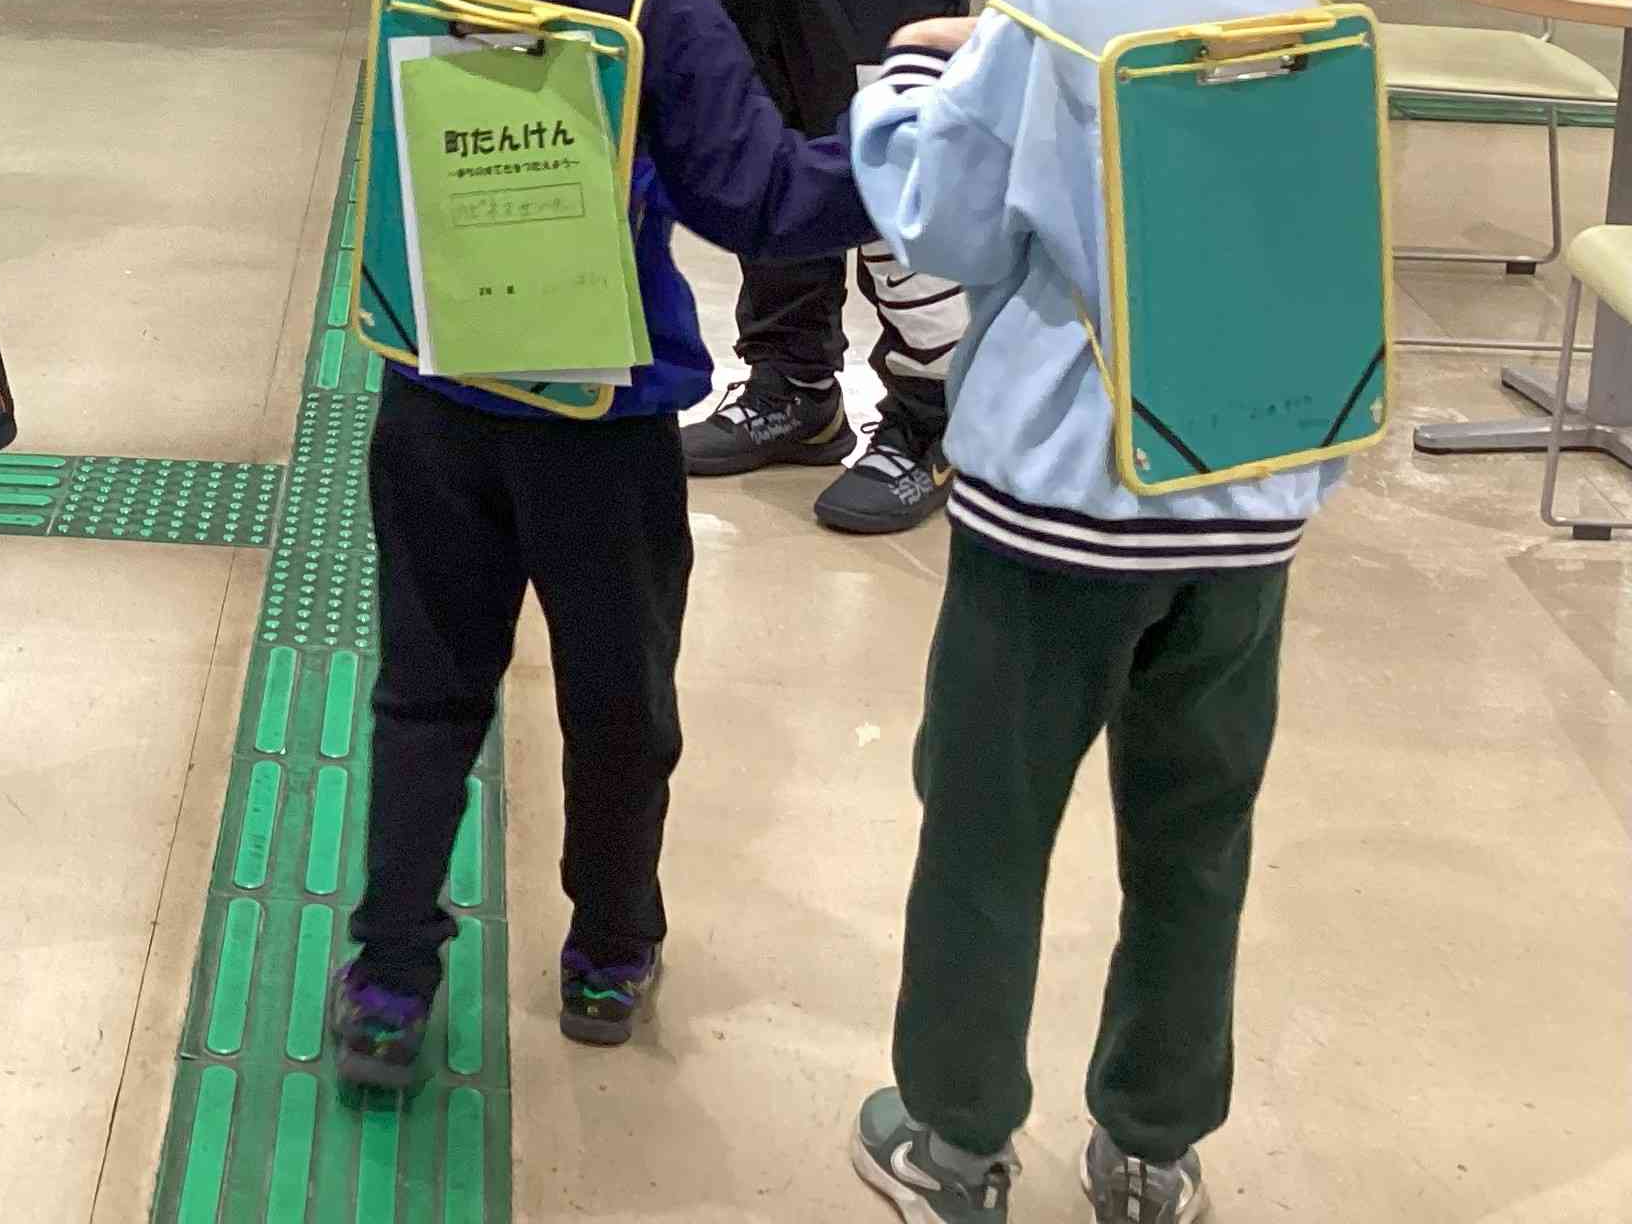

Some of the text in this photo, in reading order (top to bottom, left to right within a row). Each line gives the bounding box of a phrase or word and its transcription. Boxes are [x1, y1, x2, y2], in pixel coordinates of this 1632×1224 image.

[444, 120, 575, 157] 町たんけん
